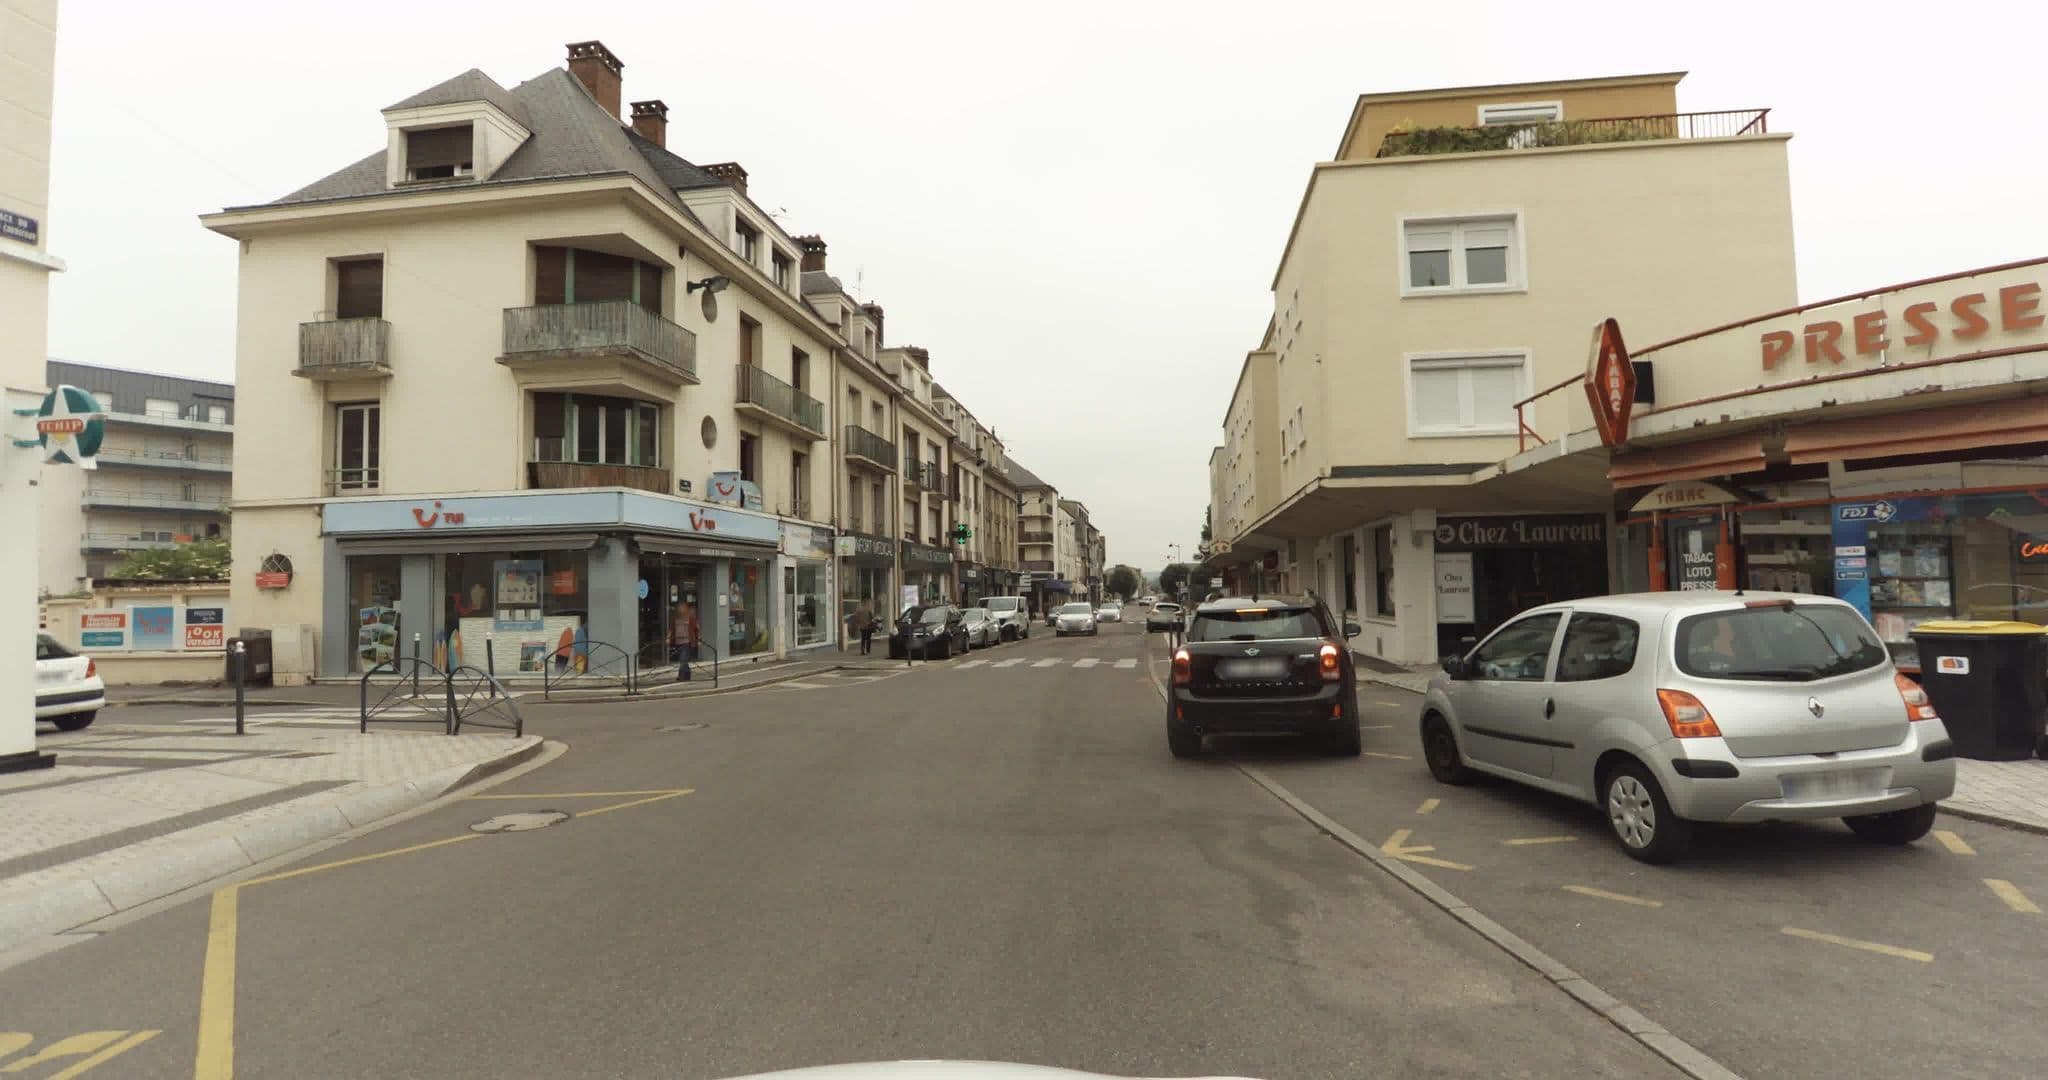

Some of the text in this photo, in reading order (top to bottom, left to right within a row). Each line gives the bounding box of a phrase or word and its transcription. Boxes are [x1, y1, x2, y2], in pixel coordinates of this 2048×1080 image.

[1760, 282, 2046, 372] PRESSE
[1608, 352, 1622, 413] TABAC
[40, 421, 82, 432] TCHIP
[1656, 488, 1705, 505] TABAC
[1841, 507, 1869, 518] FDJ
[1458, 519, 1601, 545] Chez Laurent
[1683, 552, 1714, 564] TABAC
[1686, 566, 1711, 578] LOTO
[187, 627, 221, 639] LOOK
